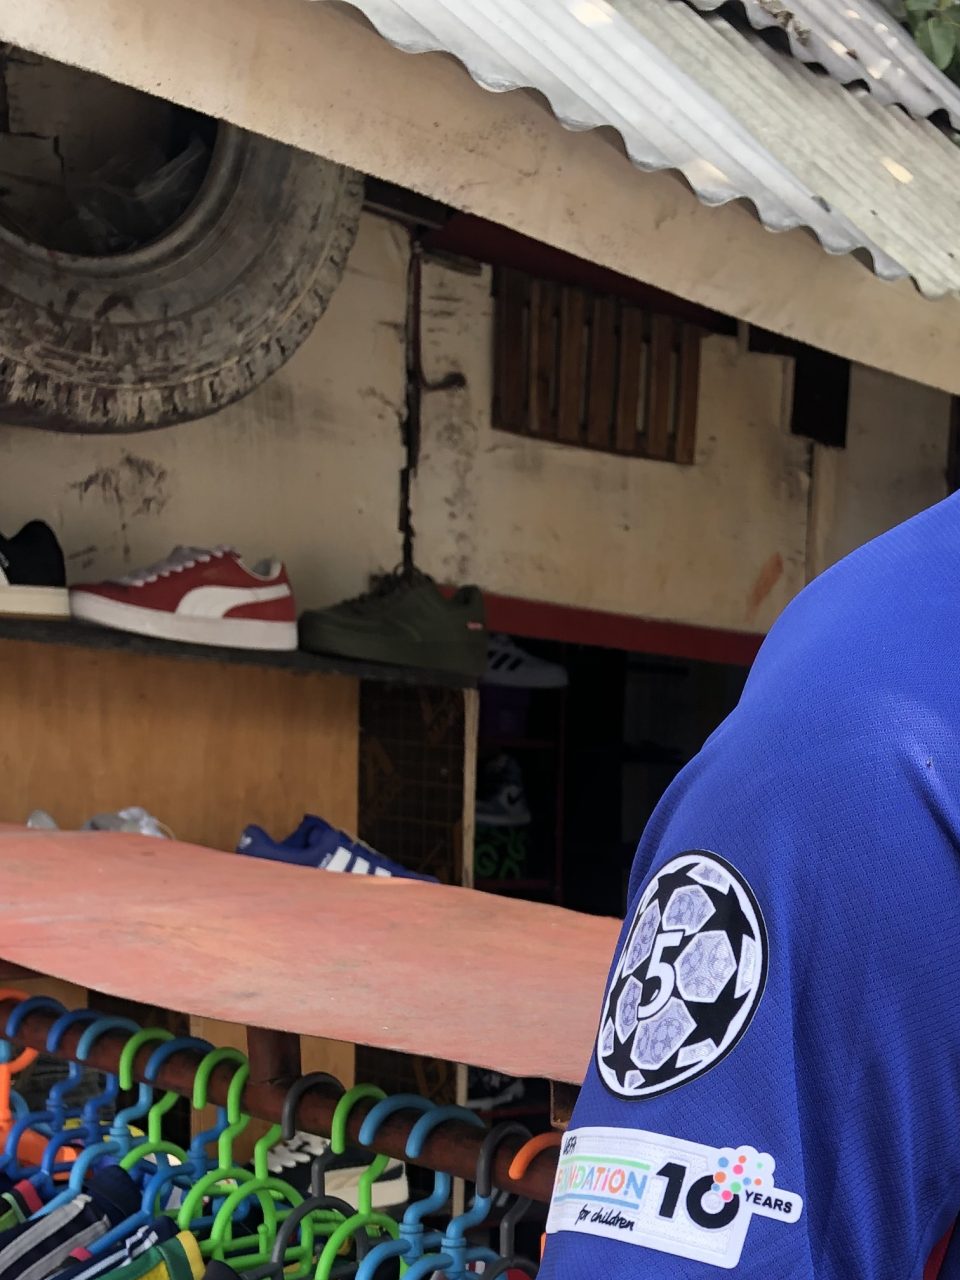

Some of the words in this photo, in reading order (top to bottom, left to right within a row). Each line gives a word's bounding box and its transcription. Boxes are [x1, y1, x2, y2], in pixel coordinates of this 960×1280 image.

[637, 930, 684, 1019] 5
[574, 1203, 592, 1226] for
[590, 1206, 635, 1232] children
[656, 1161, 740, 1229] 10
[745, 1190, 793, 1214] YEARS
